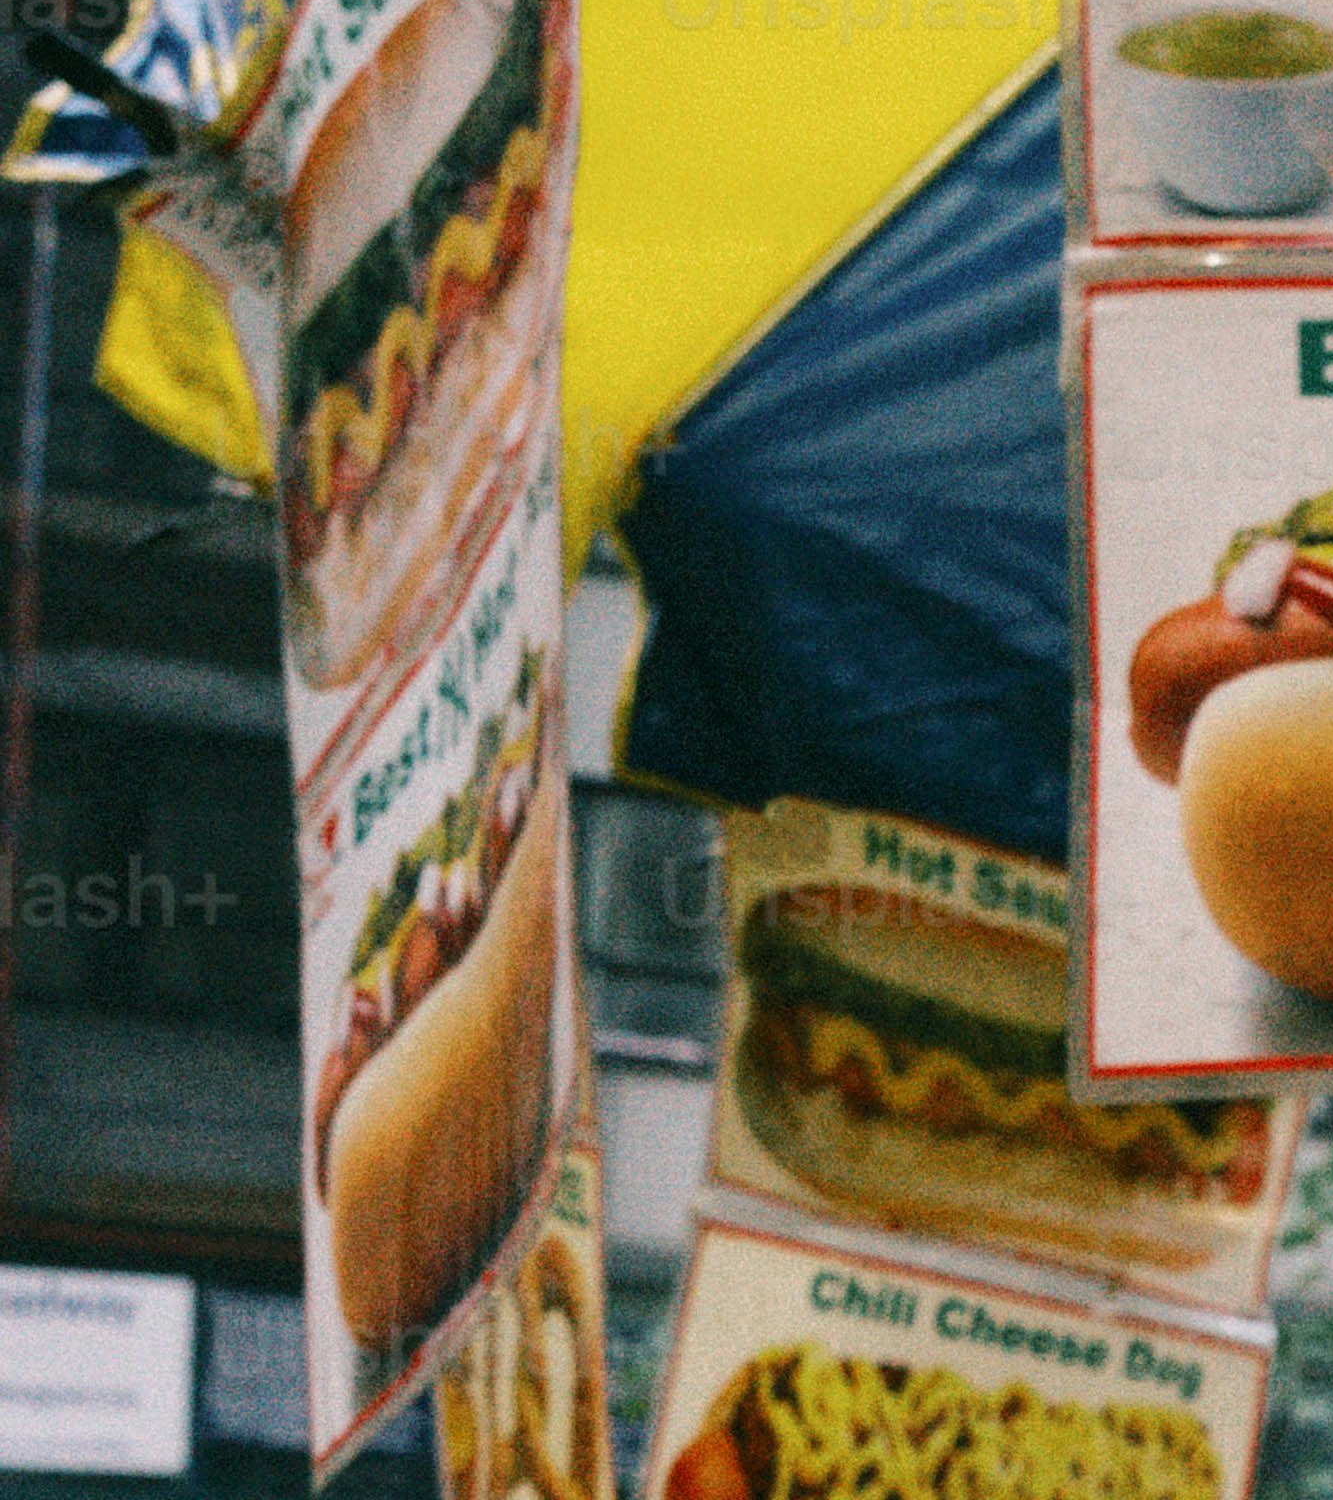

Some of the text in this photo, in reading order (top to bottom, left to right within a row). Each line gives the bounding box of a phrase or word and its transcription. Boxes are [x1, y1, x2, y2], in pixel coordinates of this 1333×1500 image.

[811, 1272, 1204, 1401] Chili Cheese Dog
